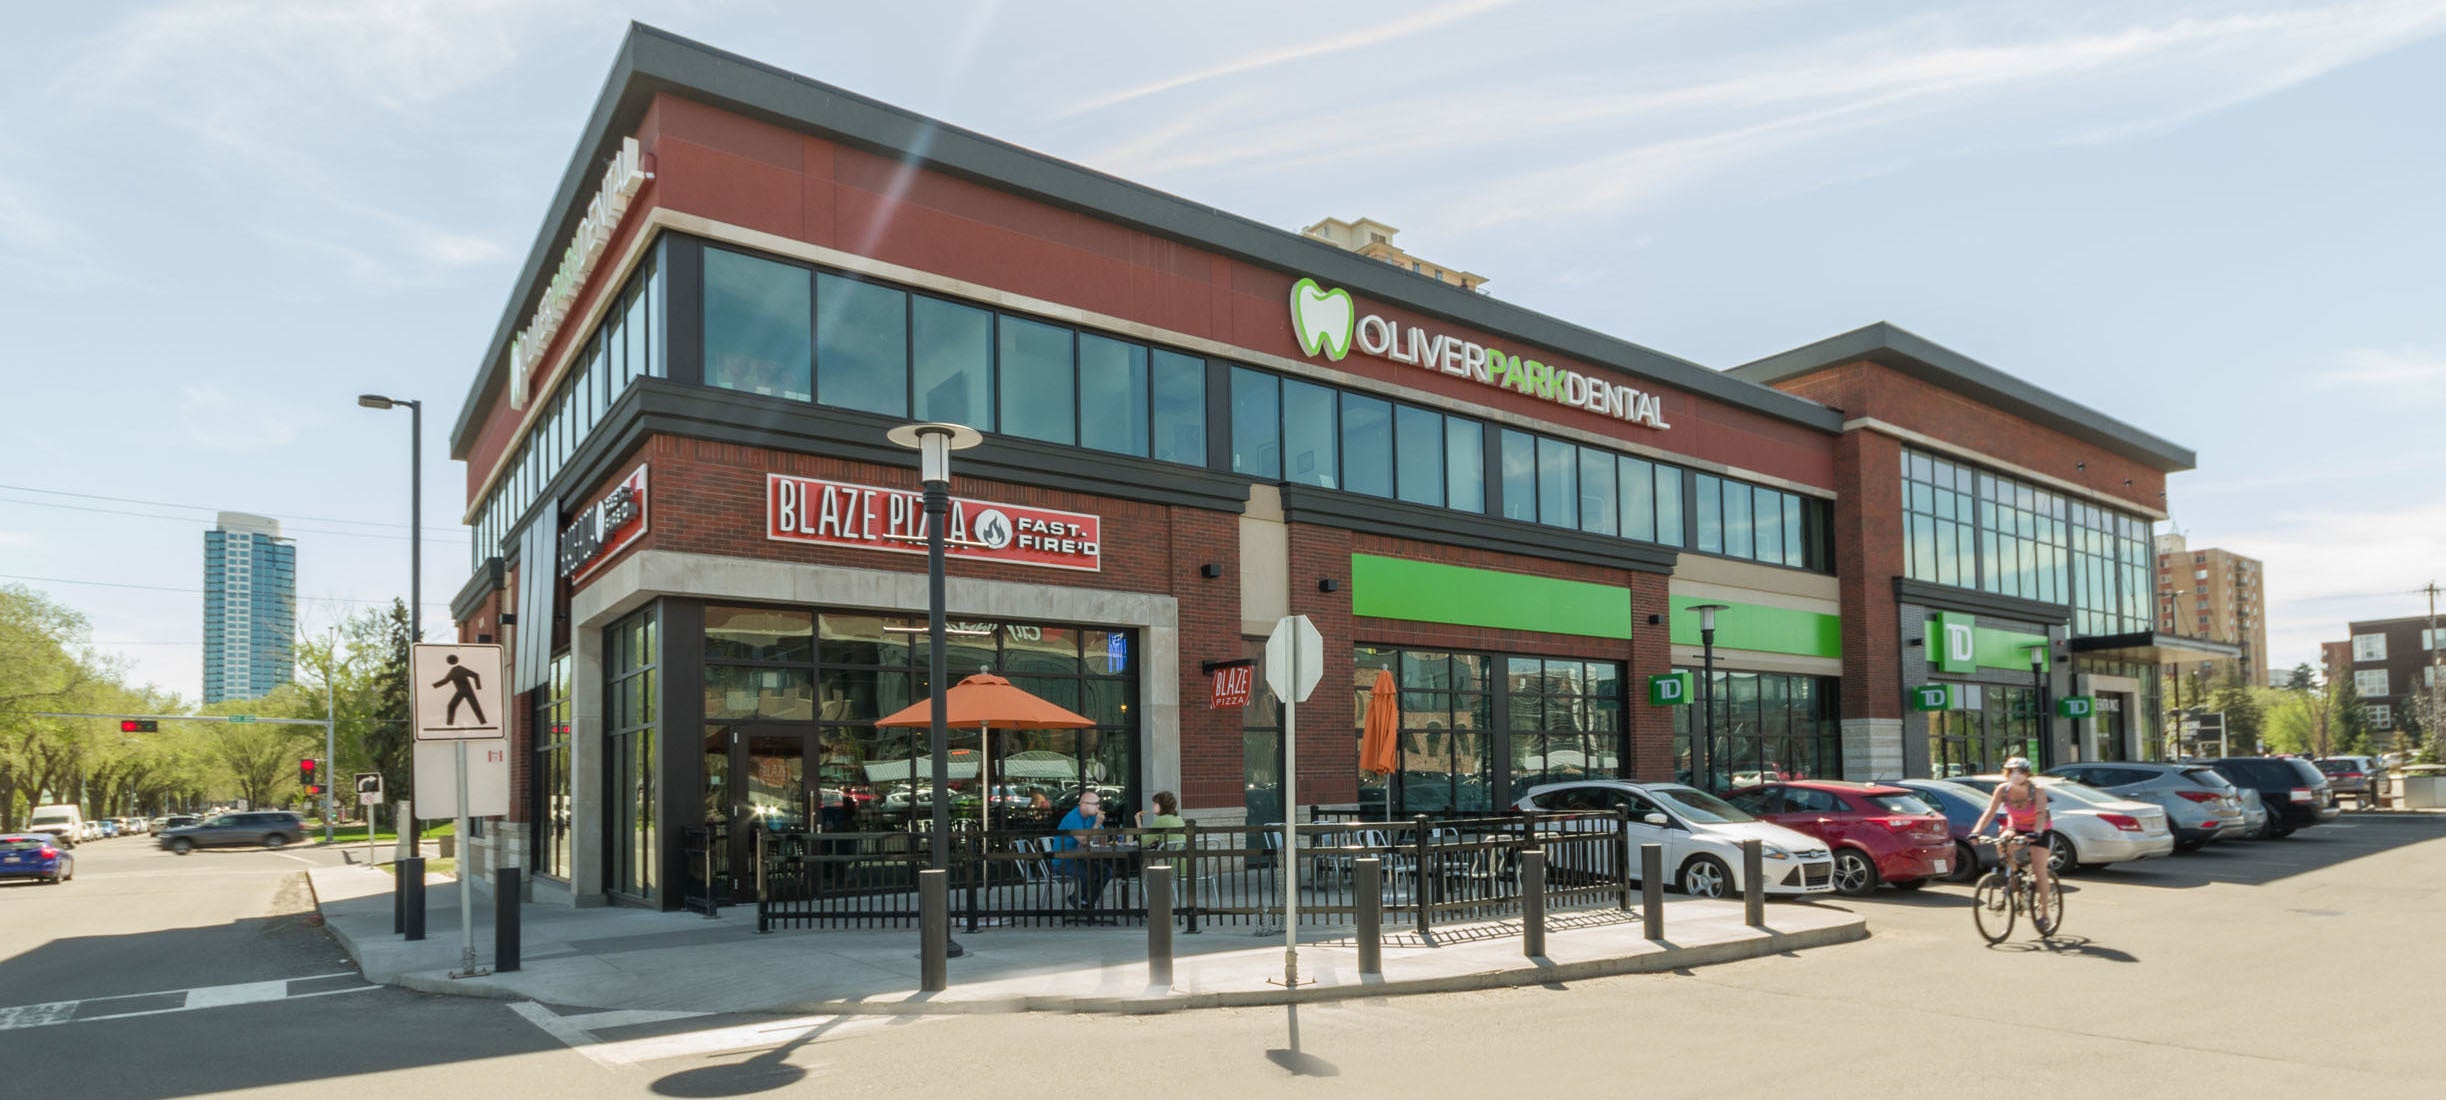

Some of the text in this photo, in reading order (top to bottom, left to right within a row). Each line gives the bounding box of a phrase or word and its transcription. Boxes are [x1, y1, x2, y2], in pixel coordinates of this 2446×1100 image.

[1356, 314, 1671, 430] OLIVERPARKDENTAL
[779, 479, 968, 549] BLAZE PIZA
[1018, 517, 1087, 537] FAST.
[1019, 534, 1098, 555] FIRE'D
[1946, 623, 1973, 661] TD
[1215, 667, 1248, 697] BLAZE
[1656, 679, 1681, 699] TD
[1216, 696, 1243, 706] PIZZA
[1920, 689, 1945, 706] TD
[2065, 700, 2088, 714] TD
